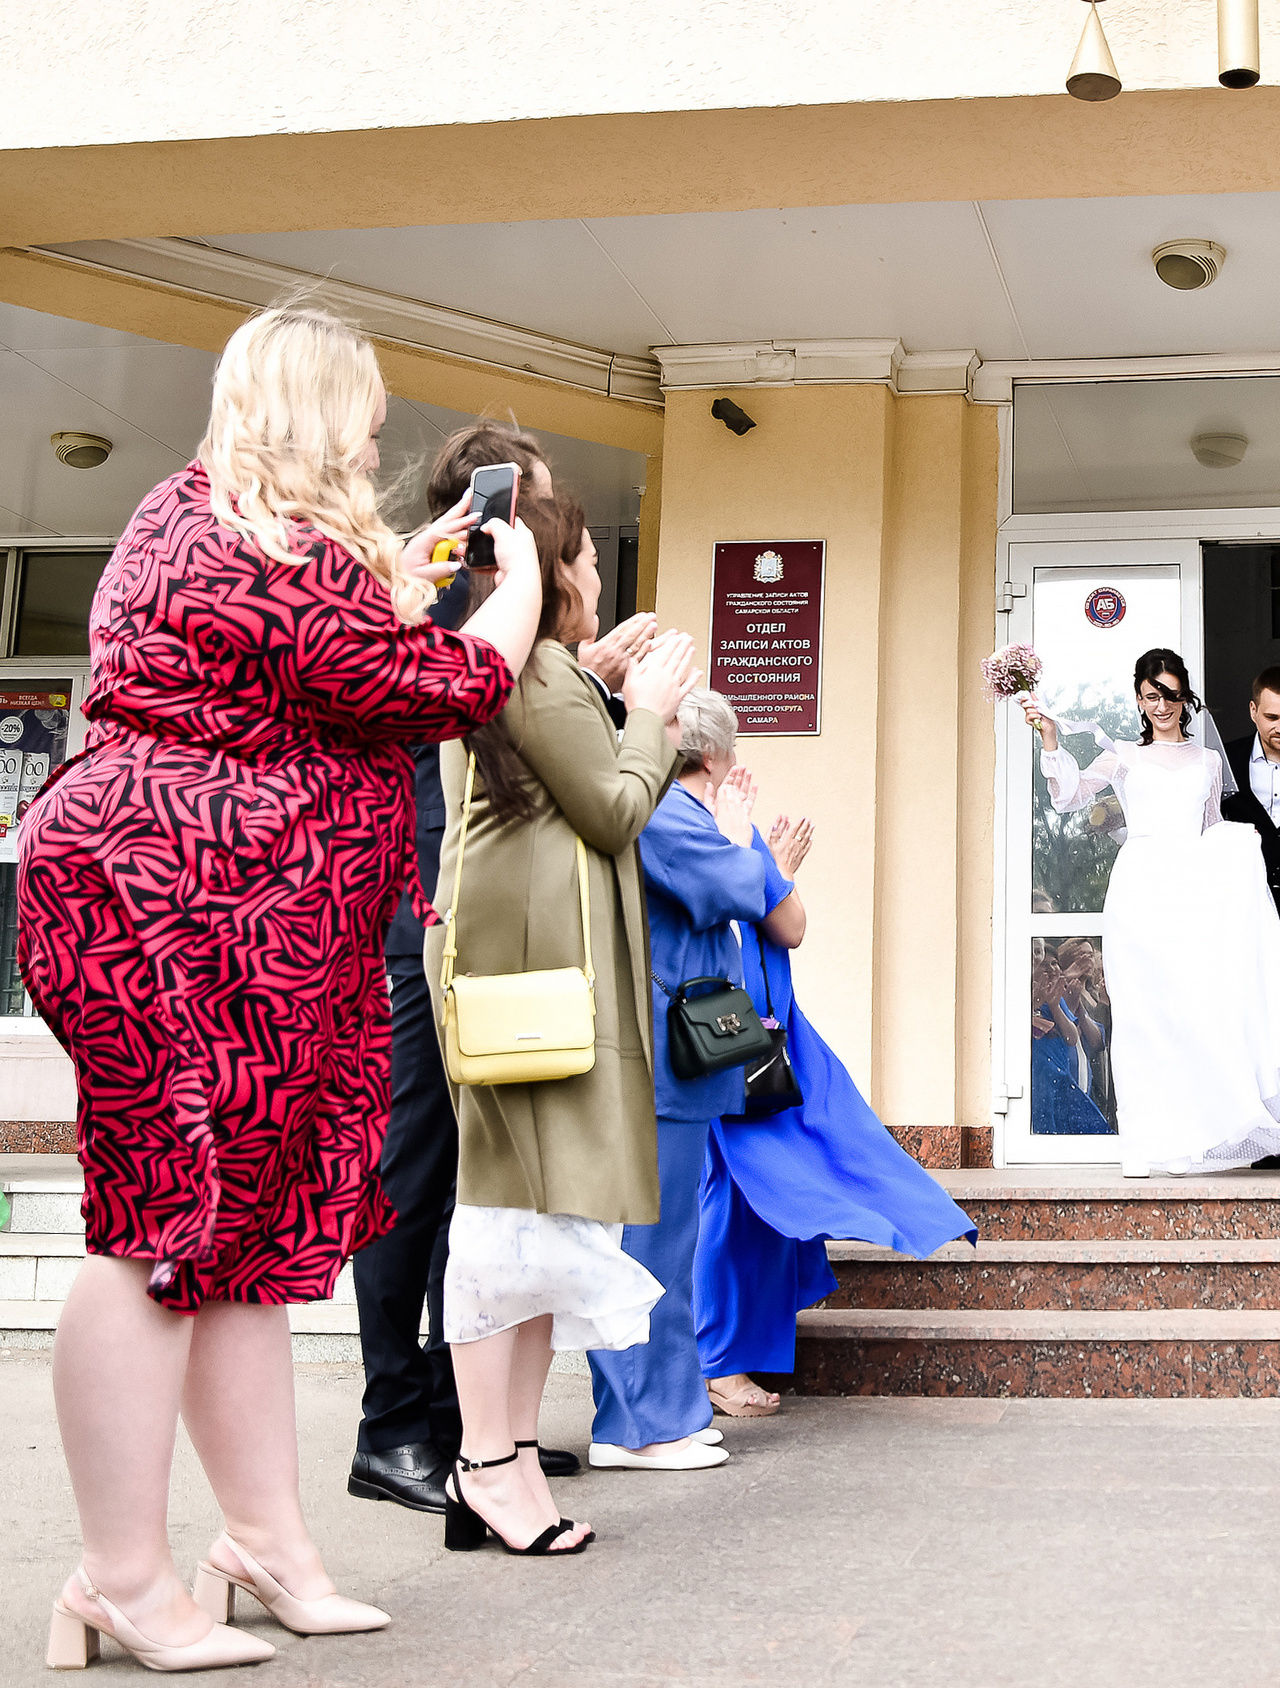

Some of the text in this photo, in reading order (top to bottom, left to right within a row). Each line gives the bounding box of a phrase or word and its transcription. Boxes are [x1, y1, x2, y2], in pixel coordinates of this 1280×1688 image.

[1096, 598, 1115, 611] АБ
[746, 623, 786, 634] ОТДЕЛ
[720, 639, 811, 650] ЗАПИСИ АКТОВ
[717, 656, 813, 668] ГРАЖДАНСКОГО
[727, 673, 801, 683] СОСТОЯНИЯ
[1, 723, 21, 733] -20%
